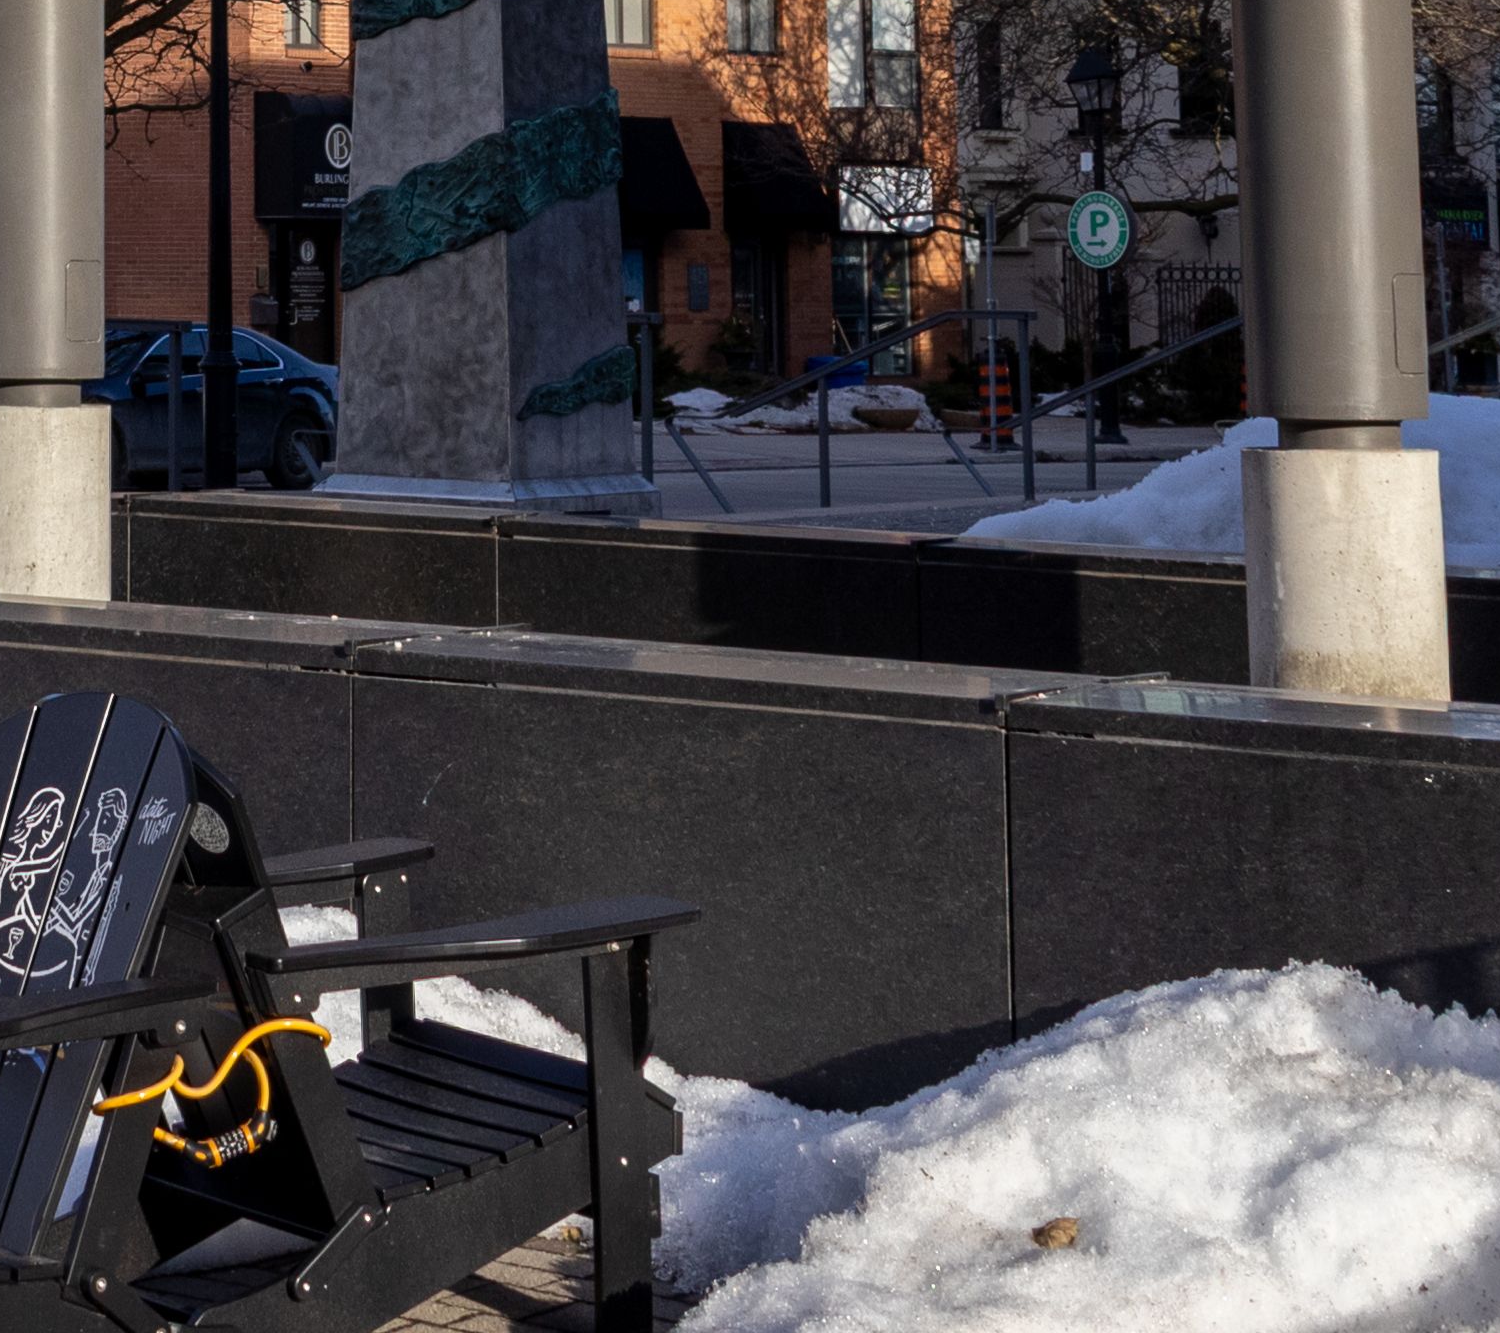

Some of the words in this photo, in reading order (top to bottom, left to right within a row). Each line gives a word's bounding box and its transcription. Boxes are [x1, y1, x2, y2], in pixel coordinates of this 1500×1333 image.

[314, 173, 350, 184] BURLING
[1090, 210, 1110, 237] P
[139, 796, 168, 819] date
[138, 812, 177, 845] NIGHT
